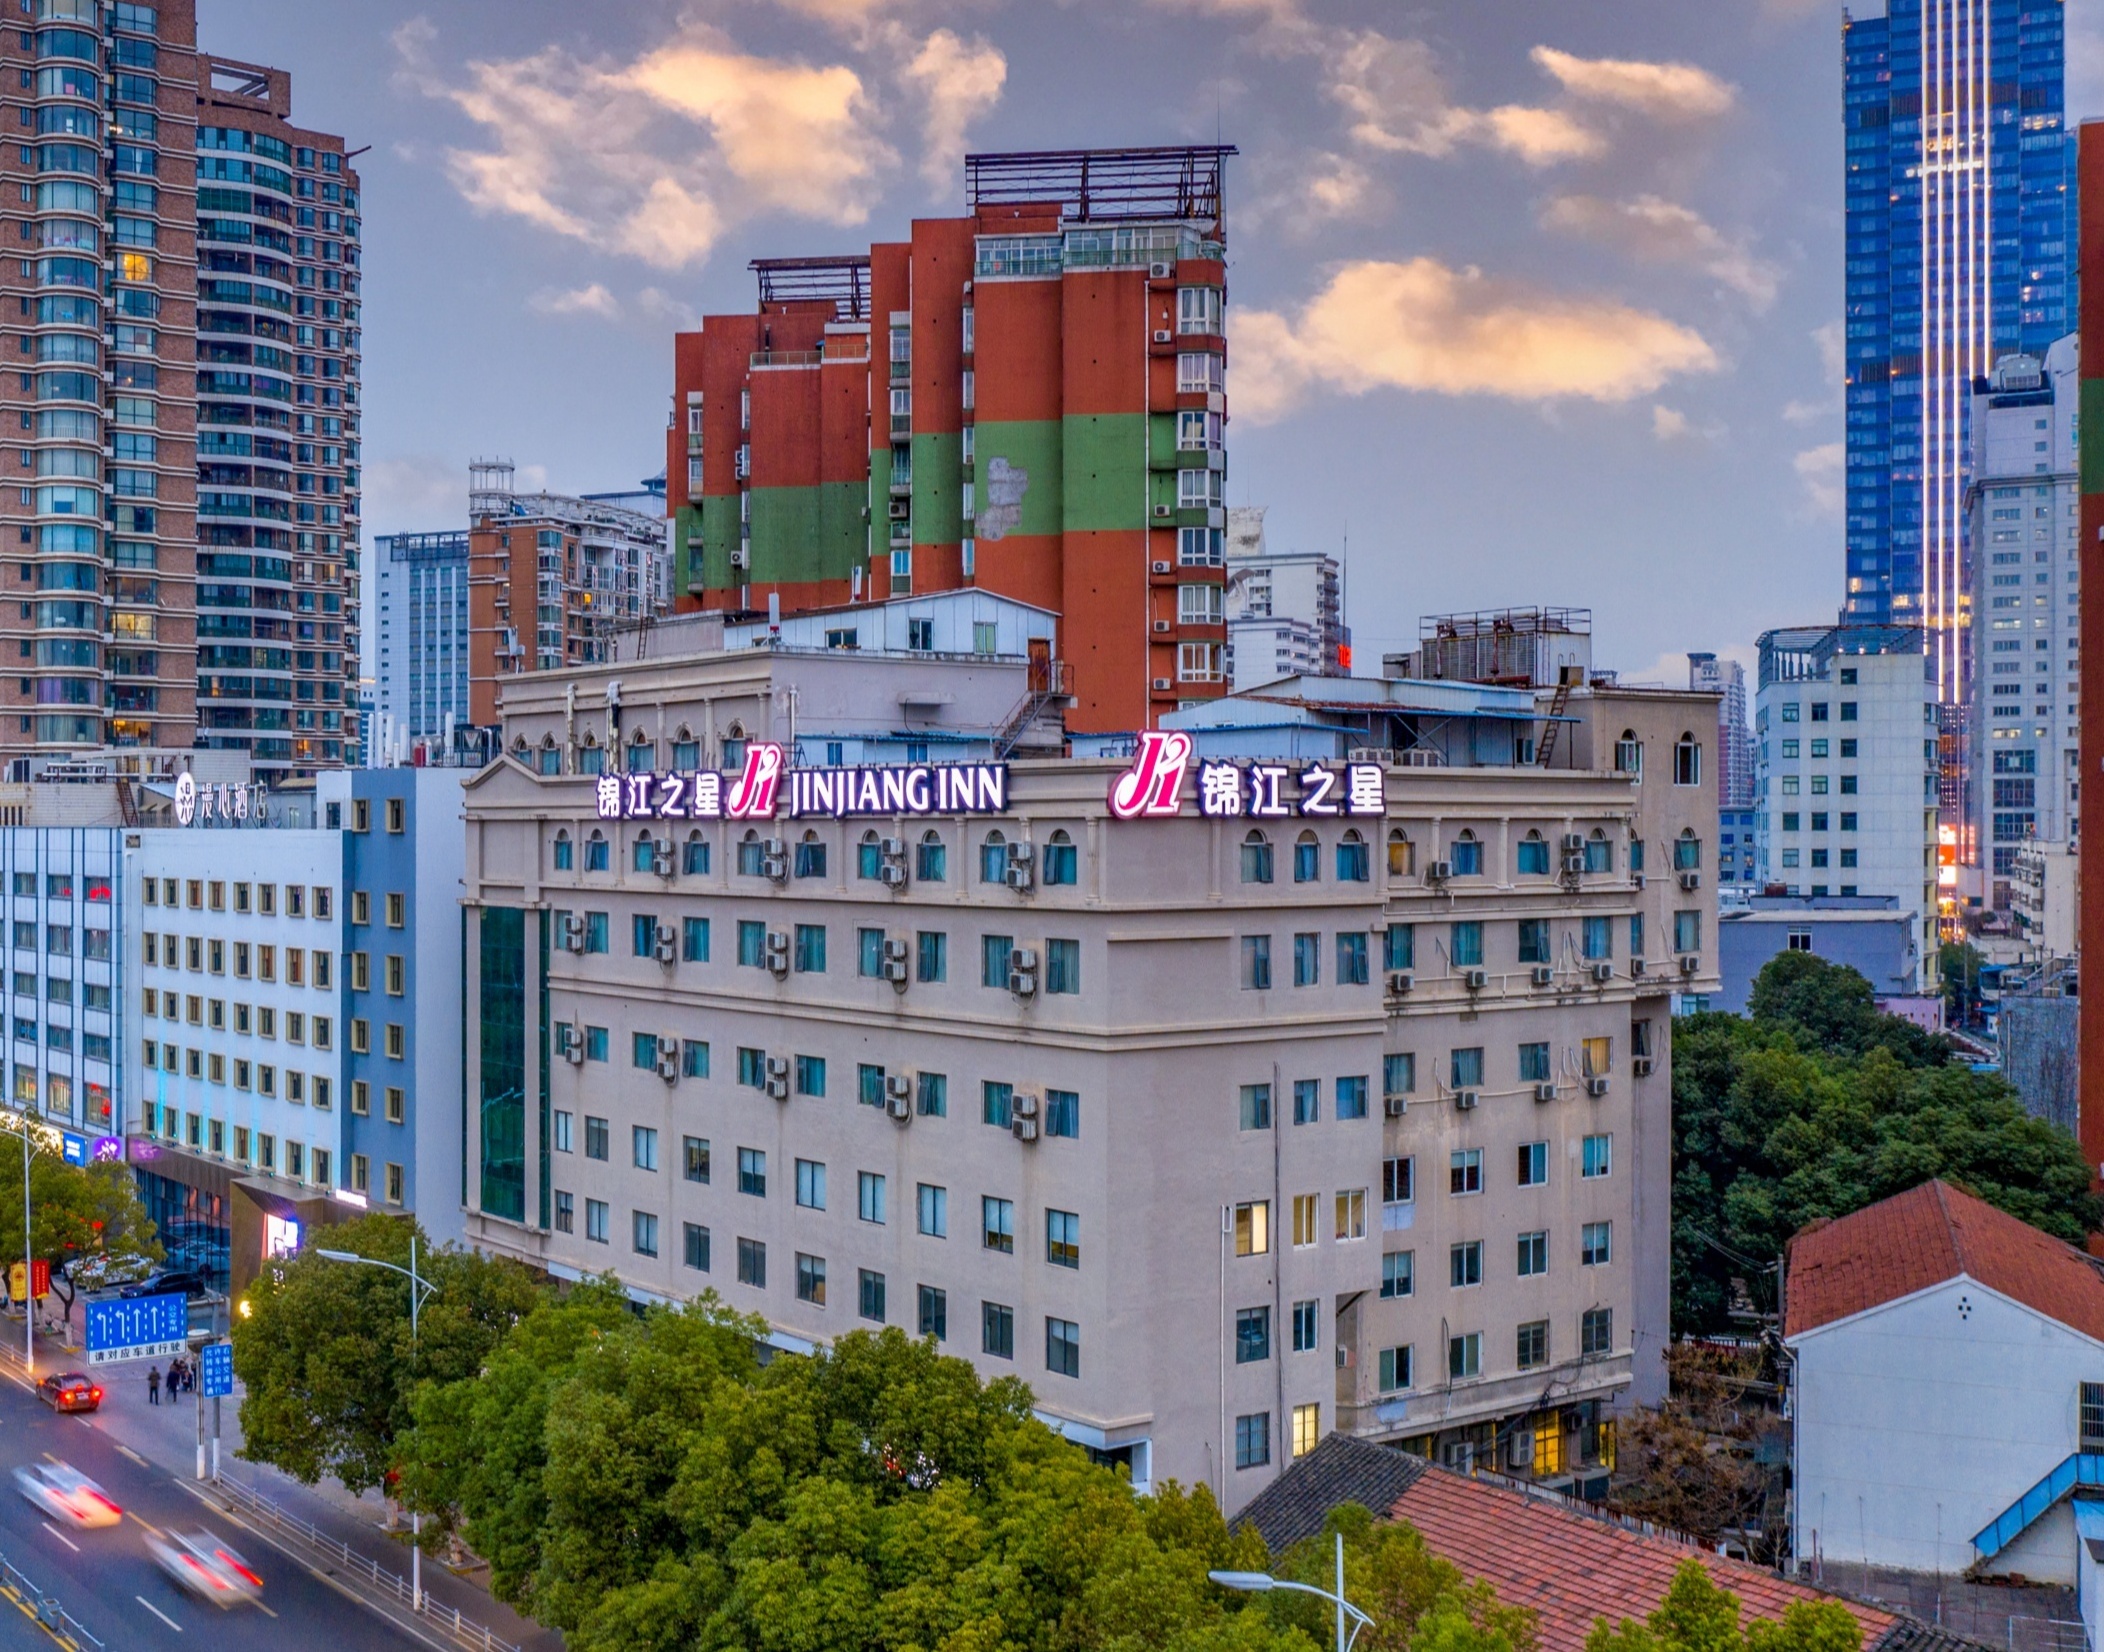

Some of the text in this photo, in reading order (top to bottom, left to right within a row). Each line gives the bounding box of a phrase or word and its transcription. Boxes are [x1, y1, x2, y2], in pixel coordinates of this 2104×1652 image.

[201, 780, 268, 819] 漫心酒店
[597, 773, 720, 817] 锦江之星
[791, 766, 1003, 816] JINJIANG INN
[1200, 762, 1385, 815] 锦江之星
[94, 1341, 181, 1362] 请对应车道行驶
